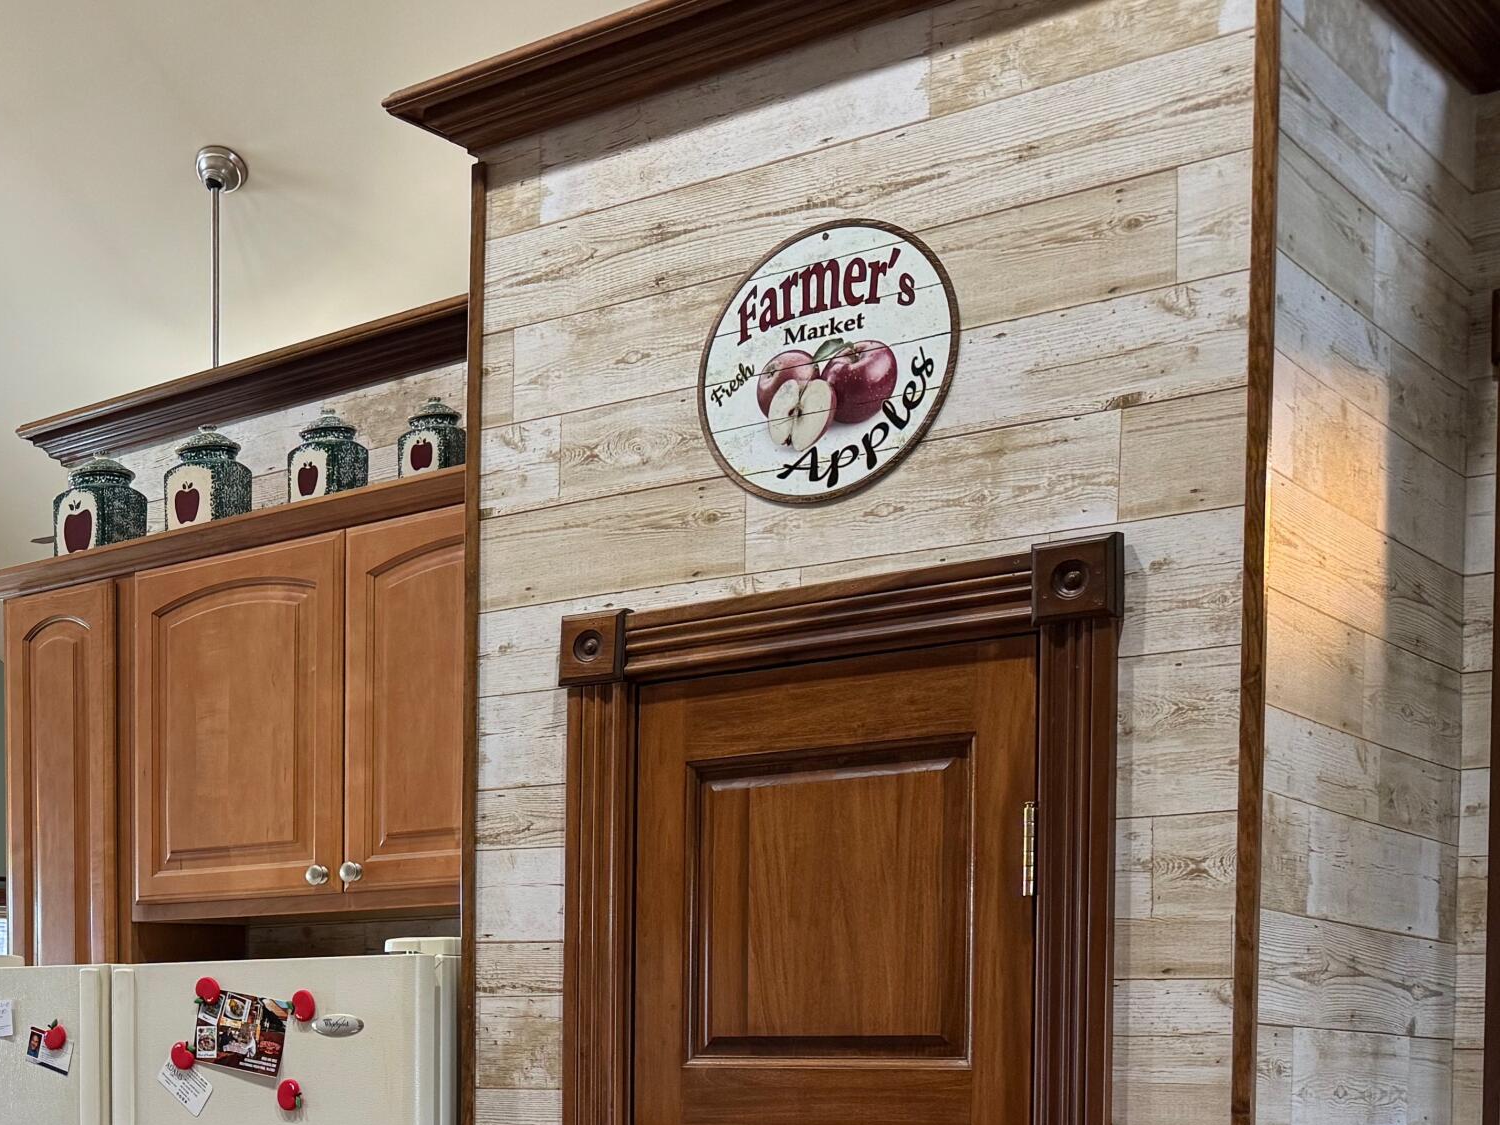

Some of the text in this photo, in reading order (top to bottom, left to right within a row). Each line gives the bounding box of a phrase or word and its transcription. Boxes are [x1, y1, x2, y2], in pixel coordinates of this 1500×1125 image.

[737, 247, 916, 346] Farmer's
[783, 312, 865, 346] Market
[710, 362, 755, 408] Fresh
[776, 346, 934, 488] Apples
